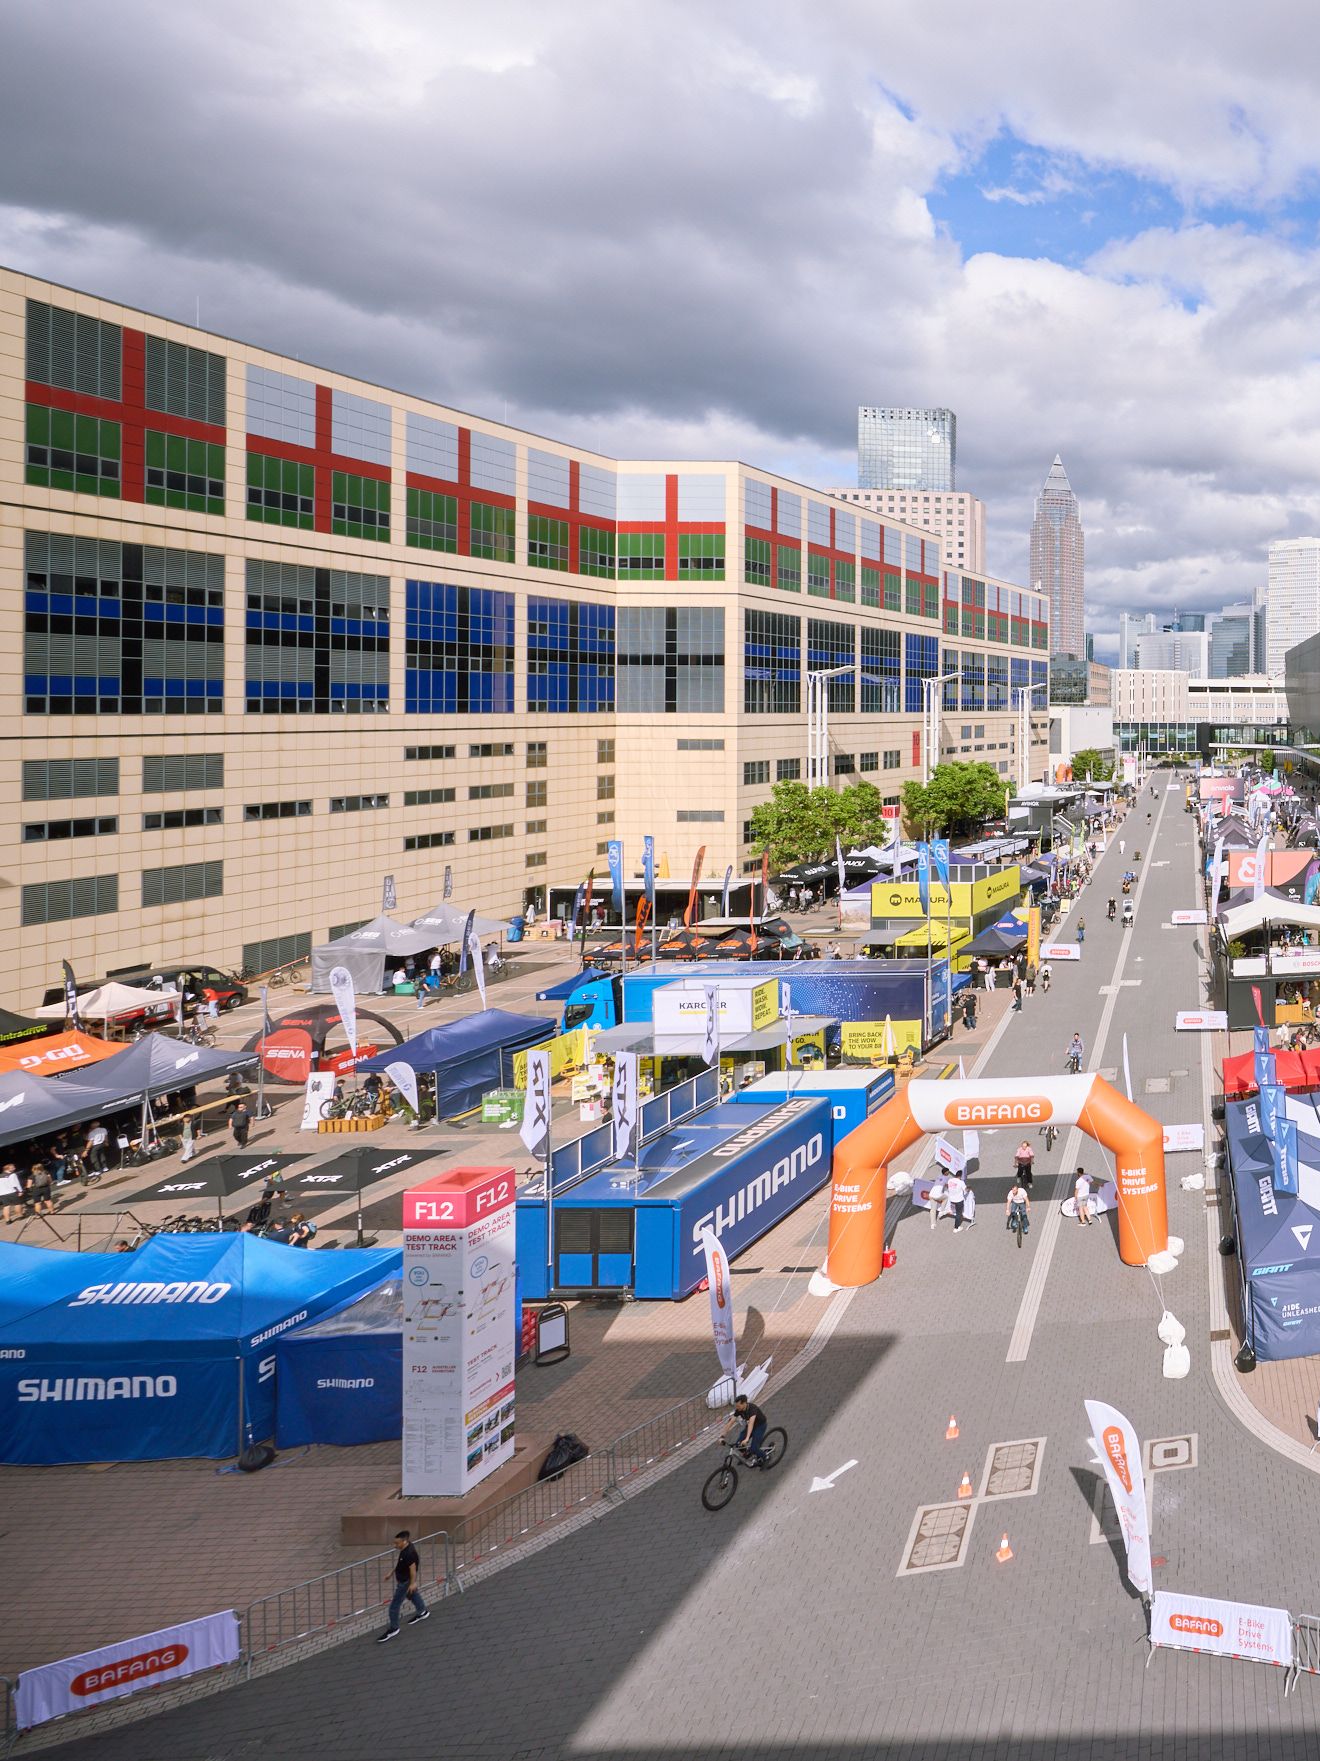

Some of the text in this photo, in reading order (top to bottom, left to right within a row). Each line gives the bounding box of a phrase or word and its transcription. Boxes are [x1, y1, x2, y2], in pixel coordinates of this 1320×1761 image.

[913, 734, 920, 746] 10
[883, 808, 894, 818] 10
[992, 882, 1010, 895] MAGURA
[904, 896, 953, 905] MAURA
[679, 1001, 727, 1009] KÄRCER
[265, 1050, 305, 1059] SENA
[338, 1054, 370, 1070] SENA
[957, 1103, 1041, 1121] BAFANG
[1245, 1103, 1261, 1134] GIANT
[713, 1100, 811, 1157] SHIMANO
[238, 1158, 278, 1179] XTR
[370, 1154, 412, 1174] XTR
[300, 1174, 343, 1183] XTR
[1121, 1168, 1147, 1176] E-BIKE
[157, 1181, 208, 1193] XTR
[834, 1184, 860, 1193] E-BIKE
[1122, 1183, 1158, 1195] SYSTEMS
[476, 1181, 509, 1213] F12
[692, 1132, 823, 1256] SHIMANO
[833, 1194, 858, 1203] DRIVE
[1258, 1175, 1279, 1216] GIANT
[415, 1201, 454, 1220] F12
[833, 1202, 872, 1213] SYSTEMS
[468, 1221, 490, 1239] DEMO
[491, 1212, 511, 1227] AREA
[468, 1220, 511, 1247] TEST TRACK
[406, 1243, 457, 1251] TEST TRACK
[1252, 1263, 1294, 1276] GIANT
[68, 1281, 232, 1307] SHIMANO
[1281, 1303, 1300, 1312] RIDE
[250, 1310, 307, 1347] SHIMANO
[412, 1365, 427, 1373] F12
[18, 1375, 177, 1401] SHIMANO
[317, 1378, 374, 1389] SHIMANO
[1175, 1617, 1218, 1633] BAFANG
[1239, 1617, 1265, 1629] E-Bike
[1239, 1628, 1262, 1639] Drive
[1239, 1639, 1274, 1653] Systems
[85, 1650, 176, 1690] BAFANG
